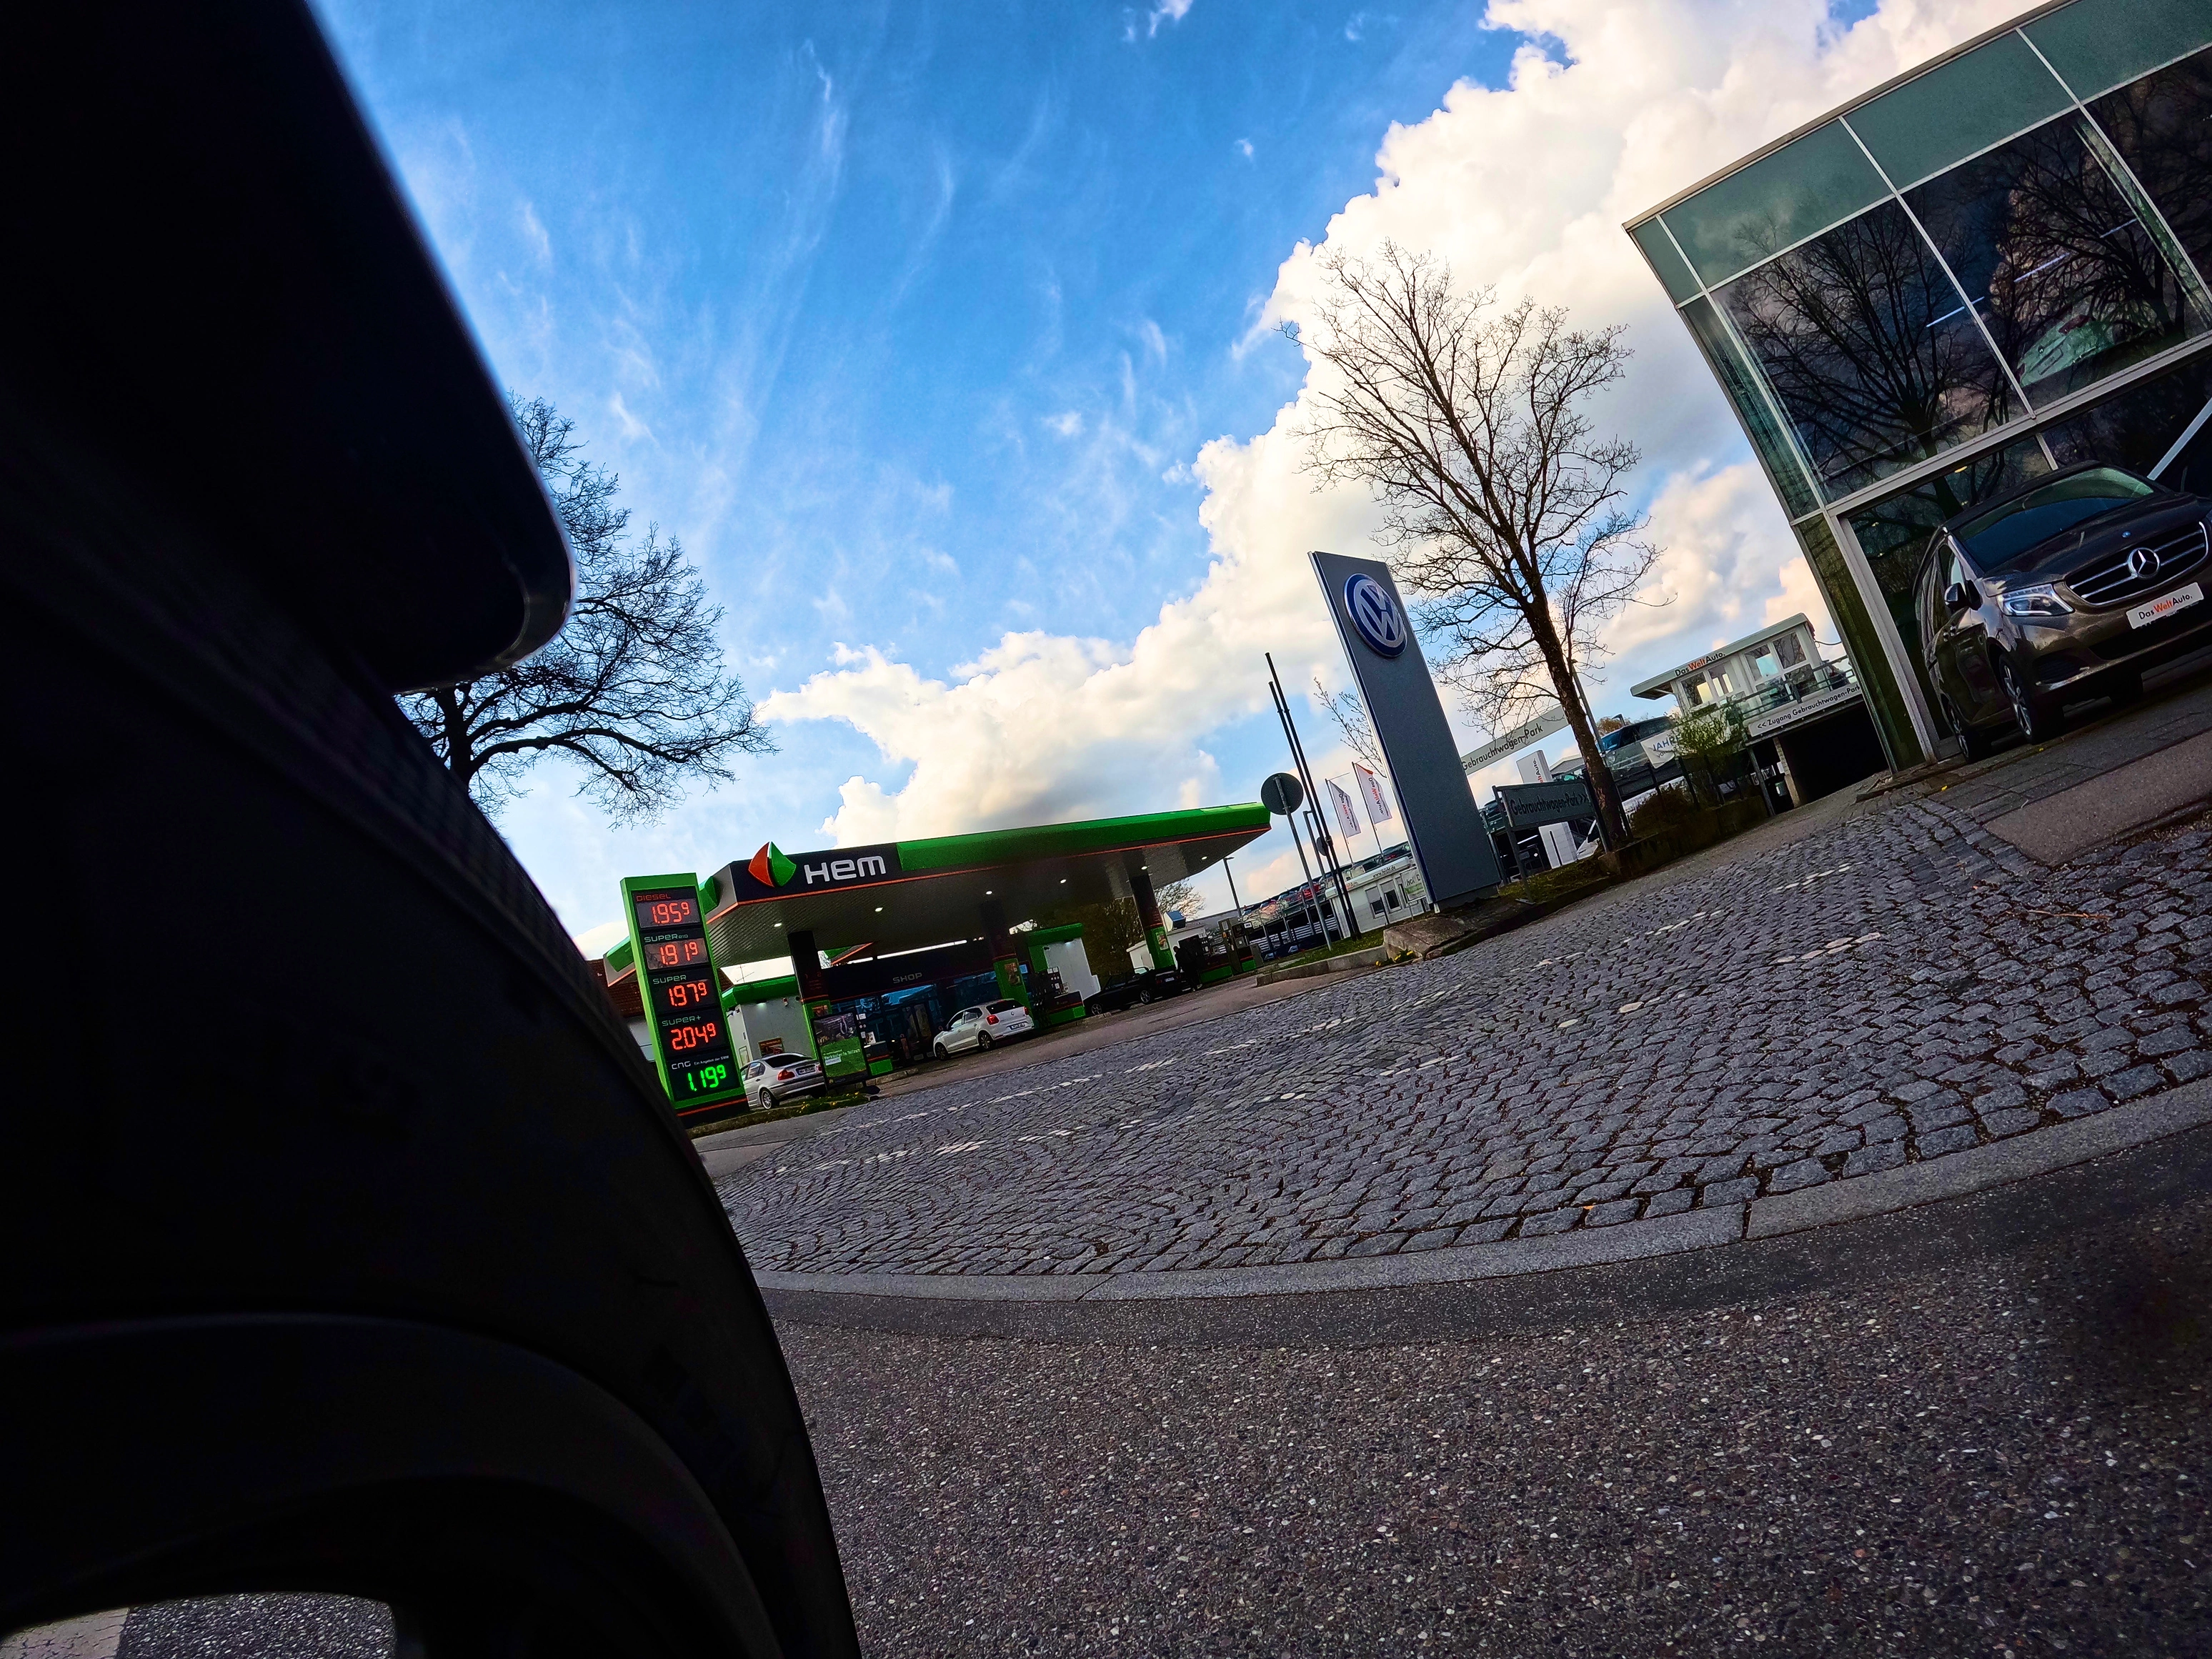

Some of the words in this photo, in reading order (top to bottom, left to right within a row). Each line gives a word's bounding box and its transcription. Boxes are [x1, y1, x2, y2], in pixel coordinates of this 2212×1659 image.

[1767, 713, 1792, 726] Zugang
[1461, 722, 1544, 771] Gebrauchtwagen-Park
[1510, 794, 1579, 816] Gebrauchtwagen-Park
[644, 933, 679, 943] SUPER
[652, 975, 687, 985] SUPER
[892, 972, 923, 984] SHOP
[672, 1061, 691, 1070] CNG
